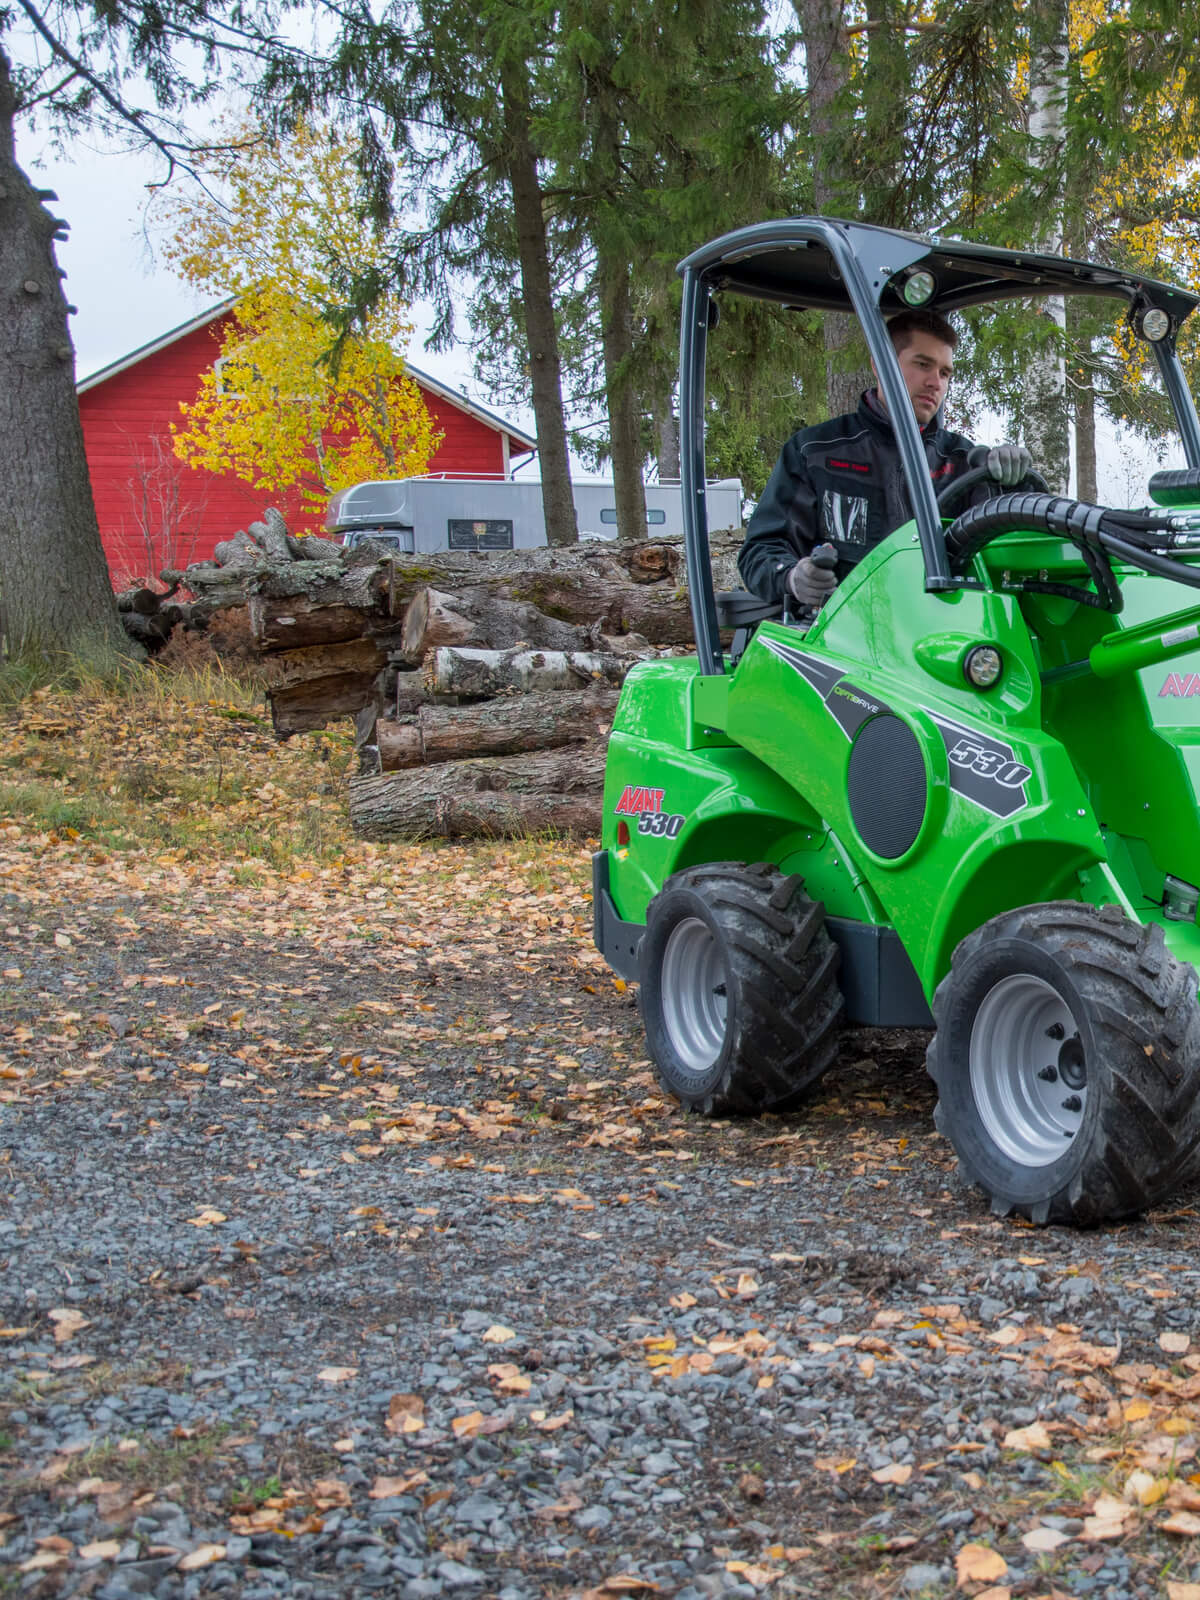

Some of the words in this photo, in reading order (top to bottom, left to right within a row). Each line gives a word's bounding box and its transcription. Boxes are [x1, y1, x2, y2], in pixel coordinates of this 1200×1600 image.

[948, 739, 1033, 788] 530
[613, 784, 666, 817] AVANT
[637, 810, 686, 840] 530
